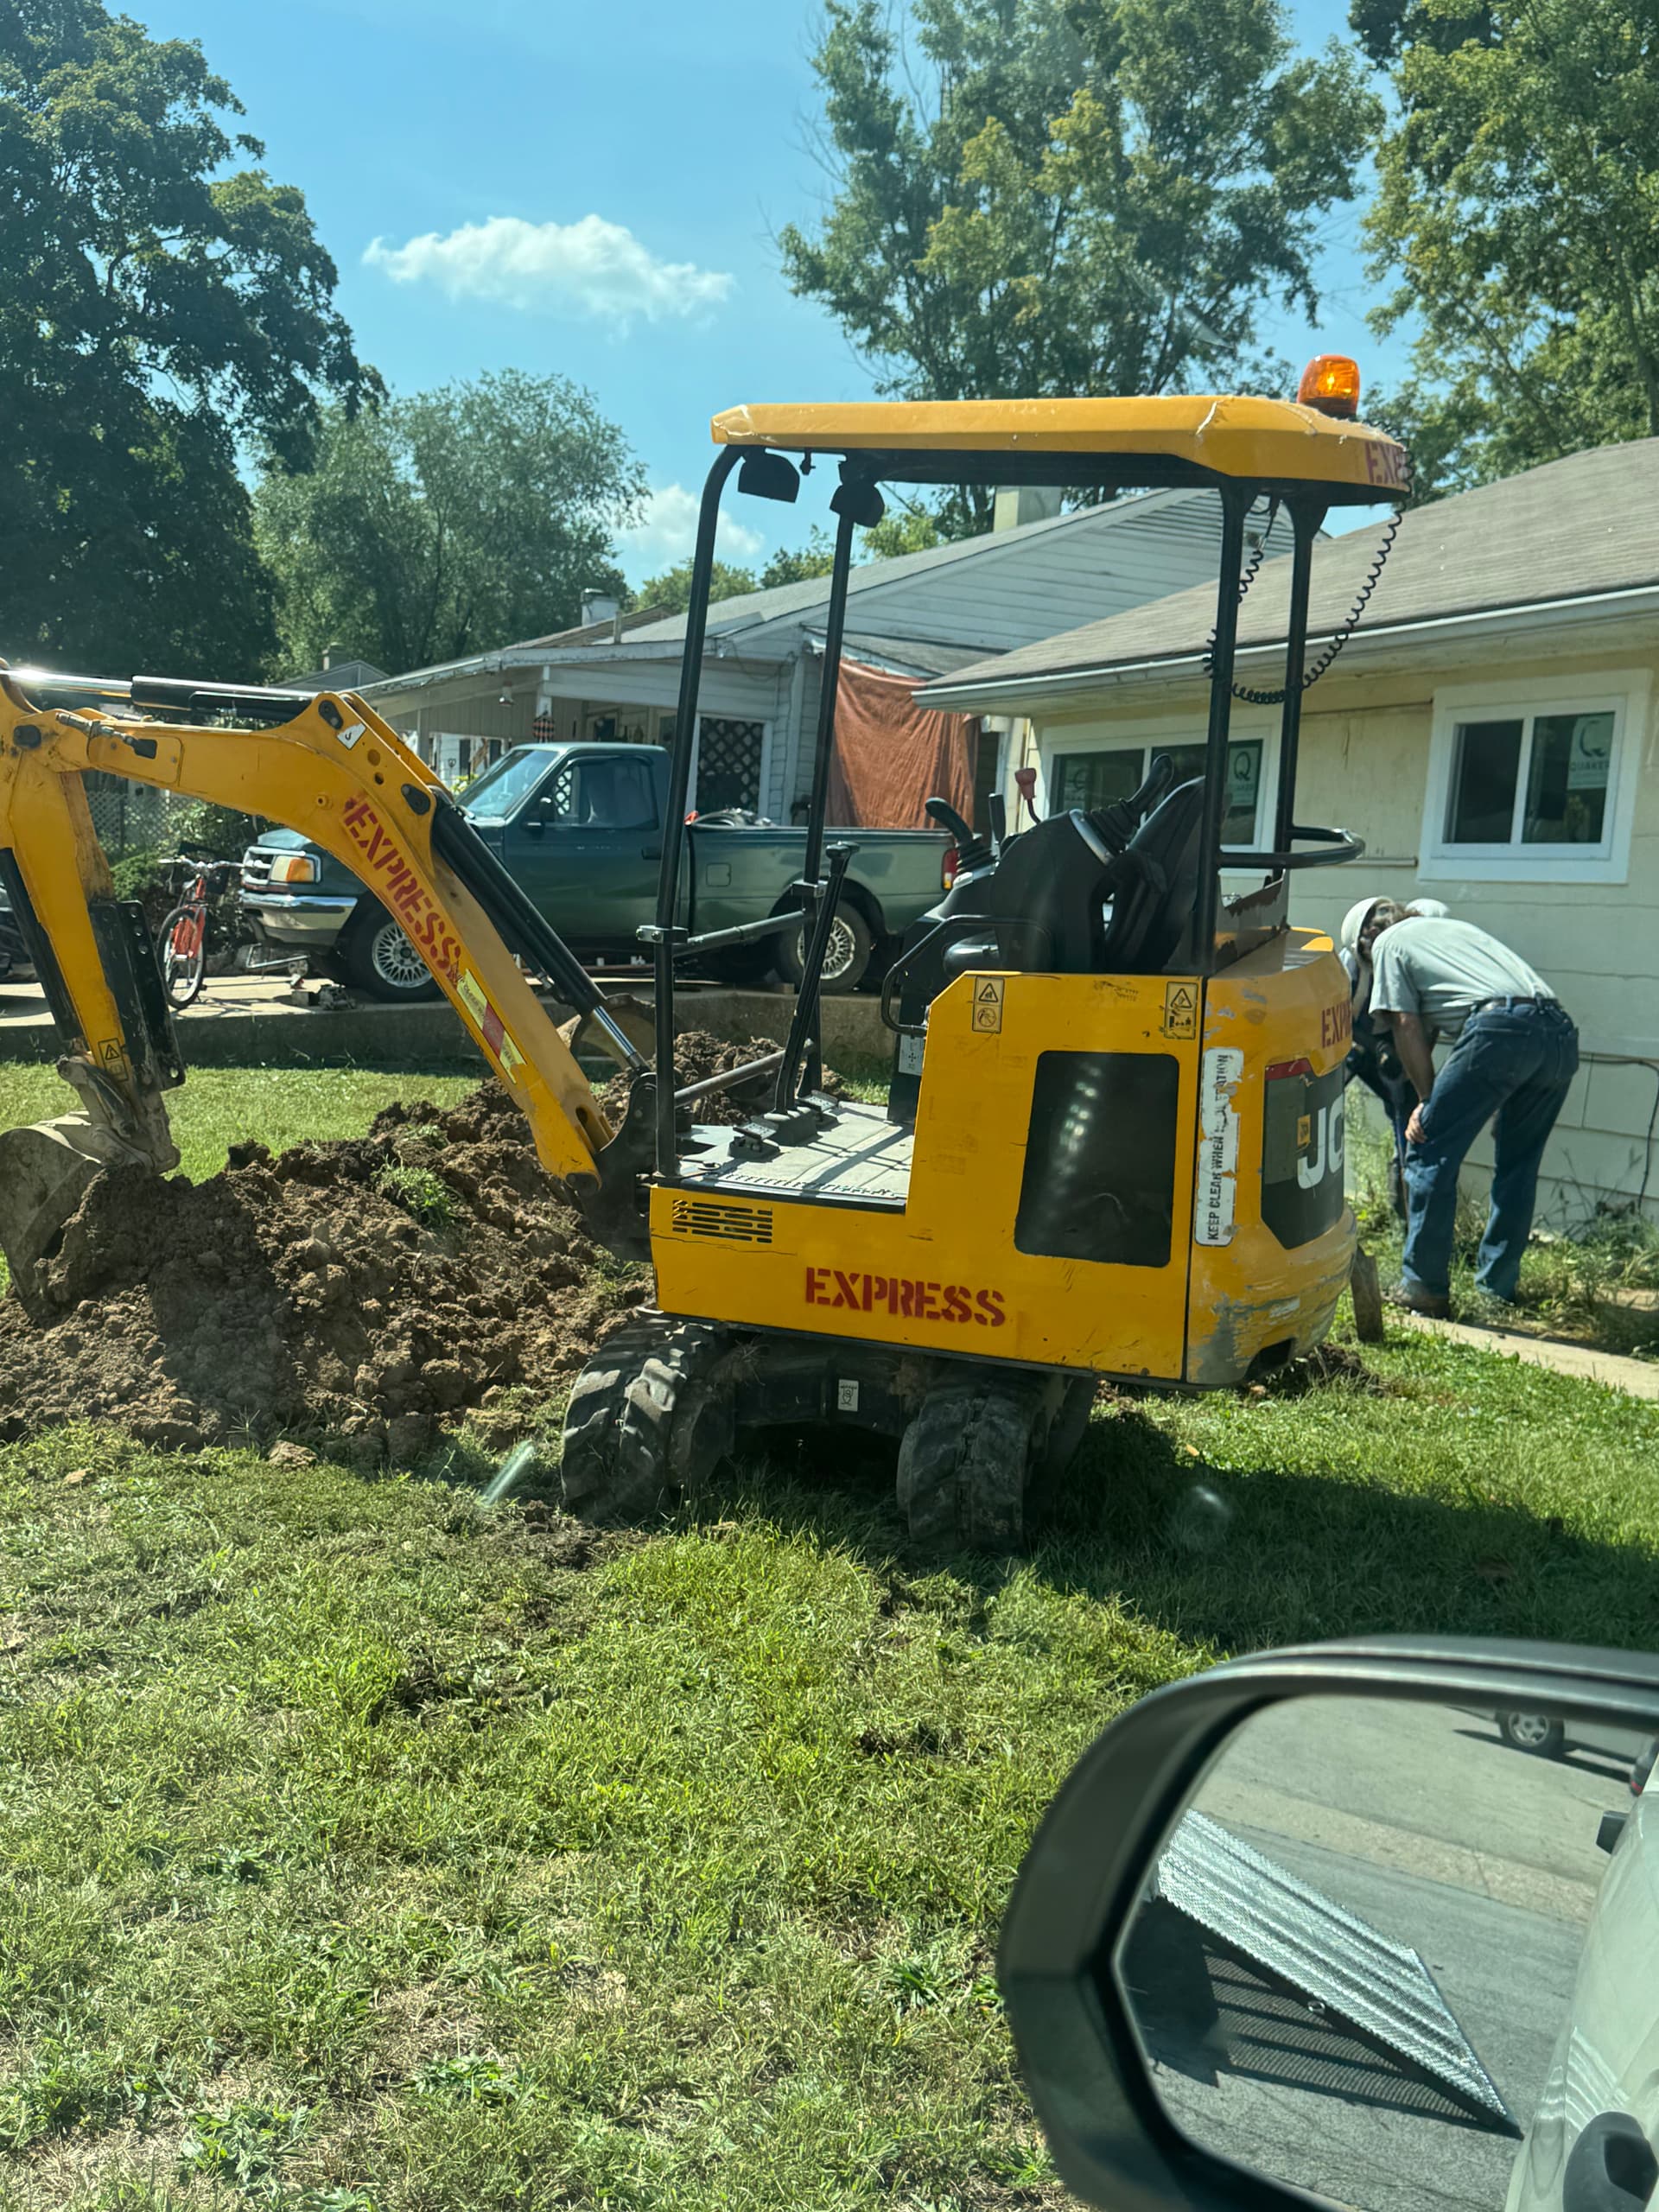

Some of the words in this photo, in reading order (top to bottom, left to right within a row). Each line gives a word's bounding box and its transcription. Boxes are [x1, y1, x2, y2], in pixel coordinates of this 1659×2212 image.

[1234, 751, 1250, 781] Q
[344, 800, 461, 969] EXPRESS
[1212, 1136, 1224, 1169] WHEN
[1208, 1211, 1220, 1240] KEEP
[805, 1267, 1006, 1327] EXPRESS
